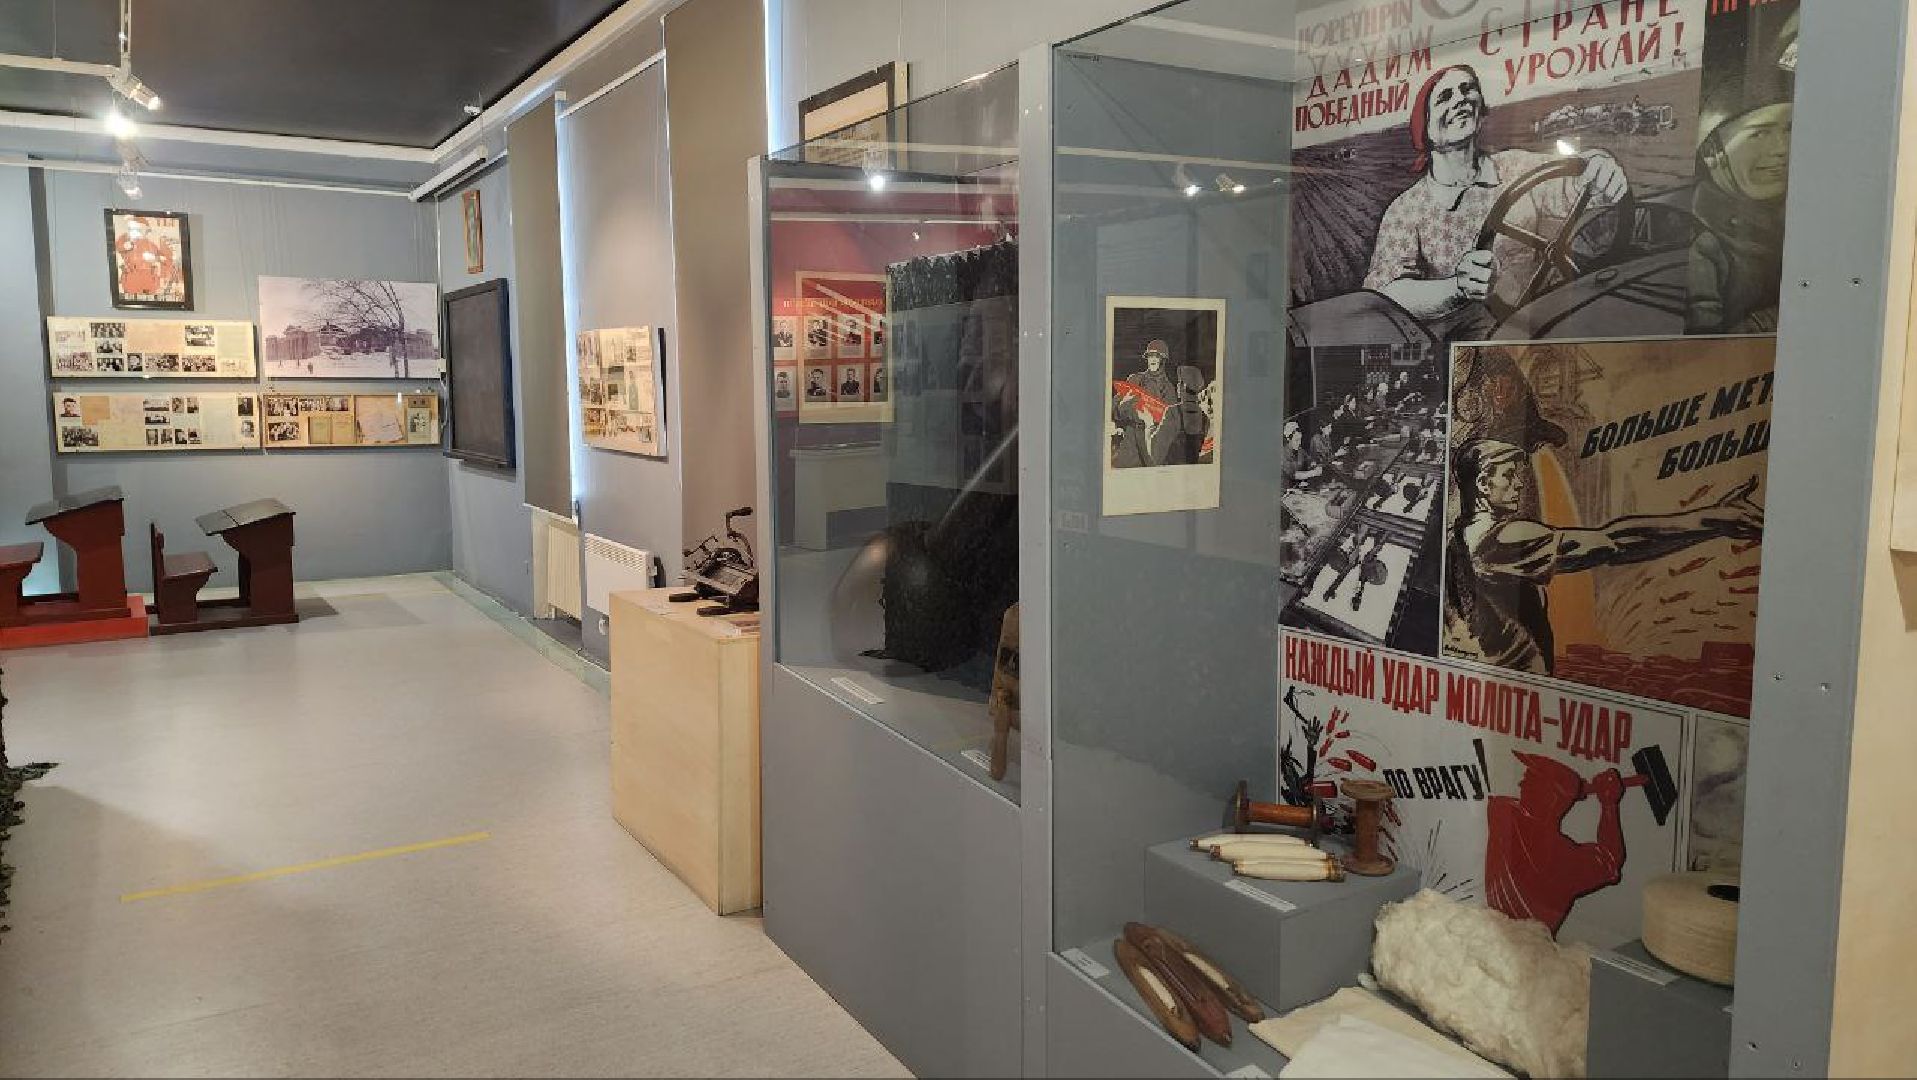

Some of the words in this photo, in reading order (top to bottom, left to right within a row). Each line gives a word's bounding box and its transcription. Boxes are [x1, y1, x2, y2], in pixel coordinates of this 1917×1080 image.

[1295, 79, 1410, 132] ПОБЕДНЫЙ
[1306, 48, 1432, 101] ДАДИМ
[1580, 392, 1708, 459] БОЛЬШЕ
[1709, 371, 1774, 420] МЕТ
[1285, 635, 1375, 700] КАЖДЫЙ
[1382, 657, 1440, 715] УДАР
[1383, 768, 1414, 799] ПО
[1419, 739, 1491, 801] ВРАГУ!
